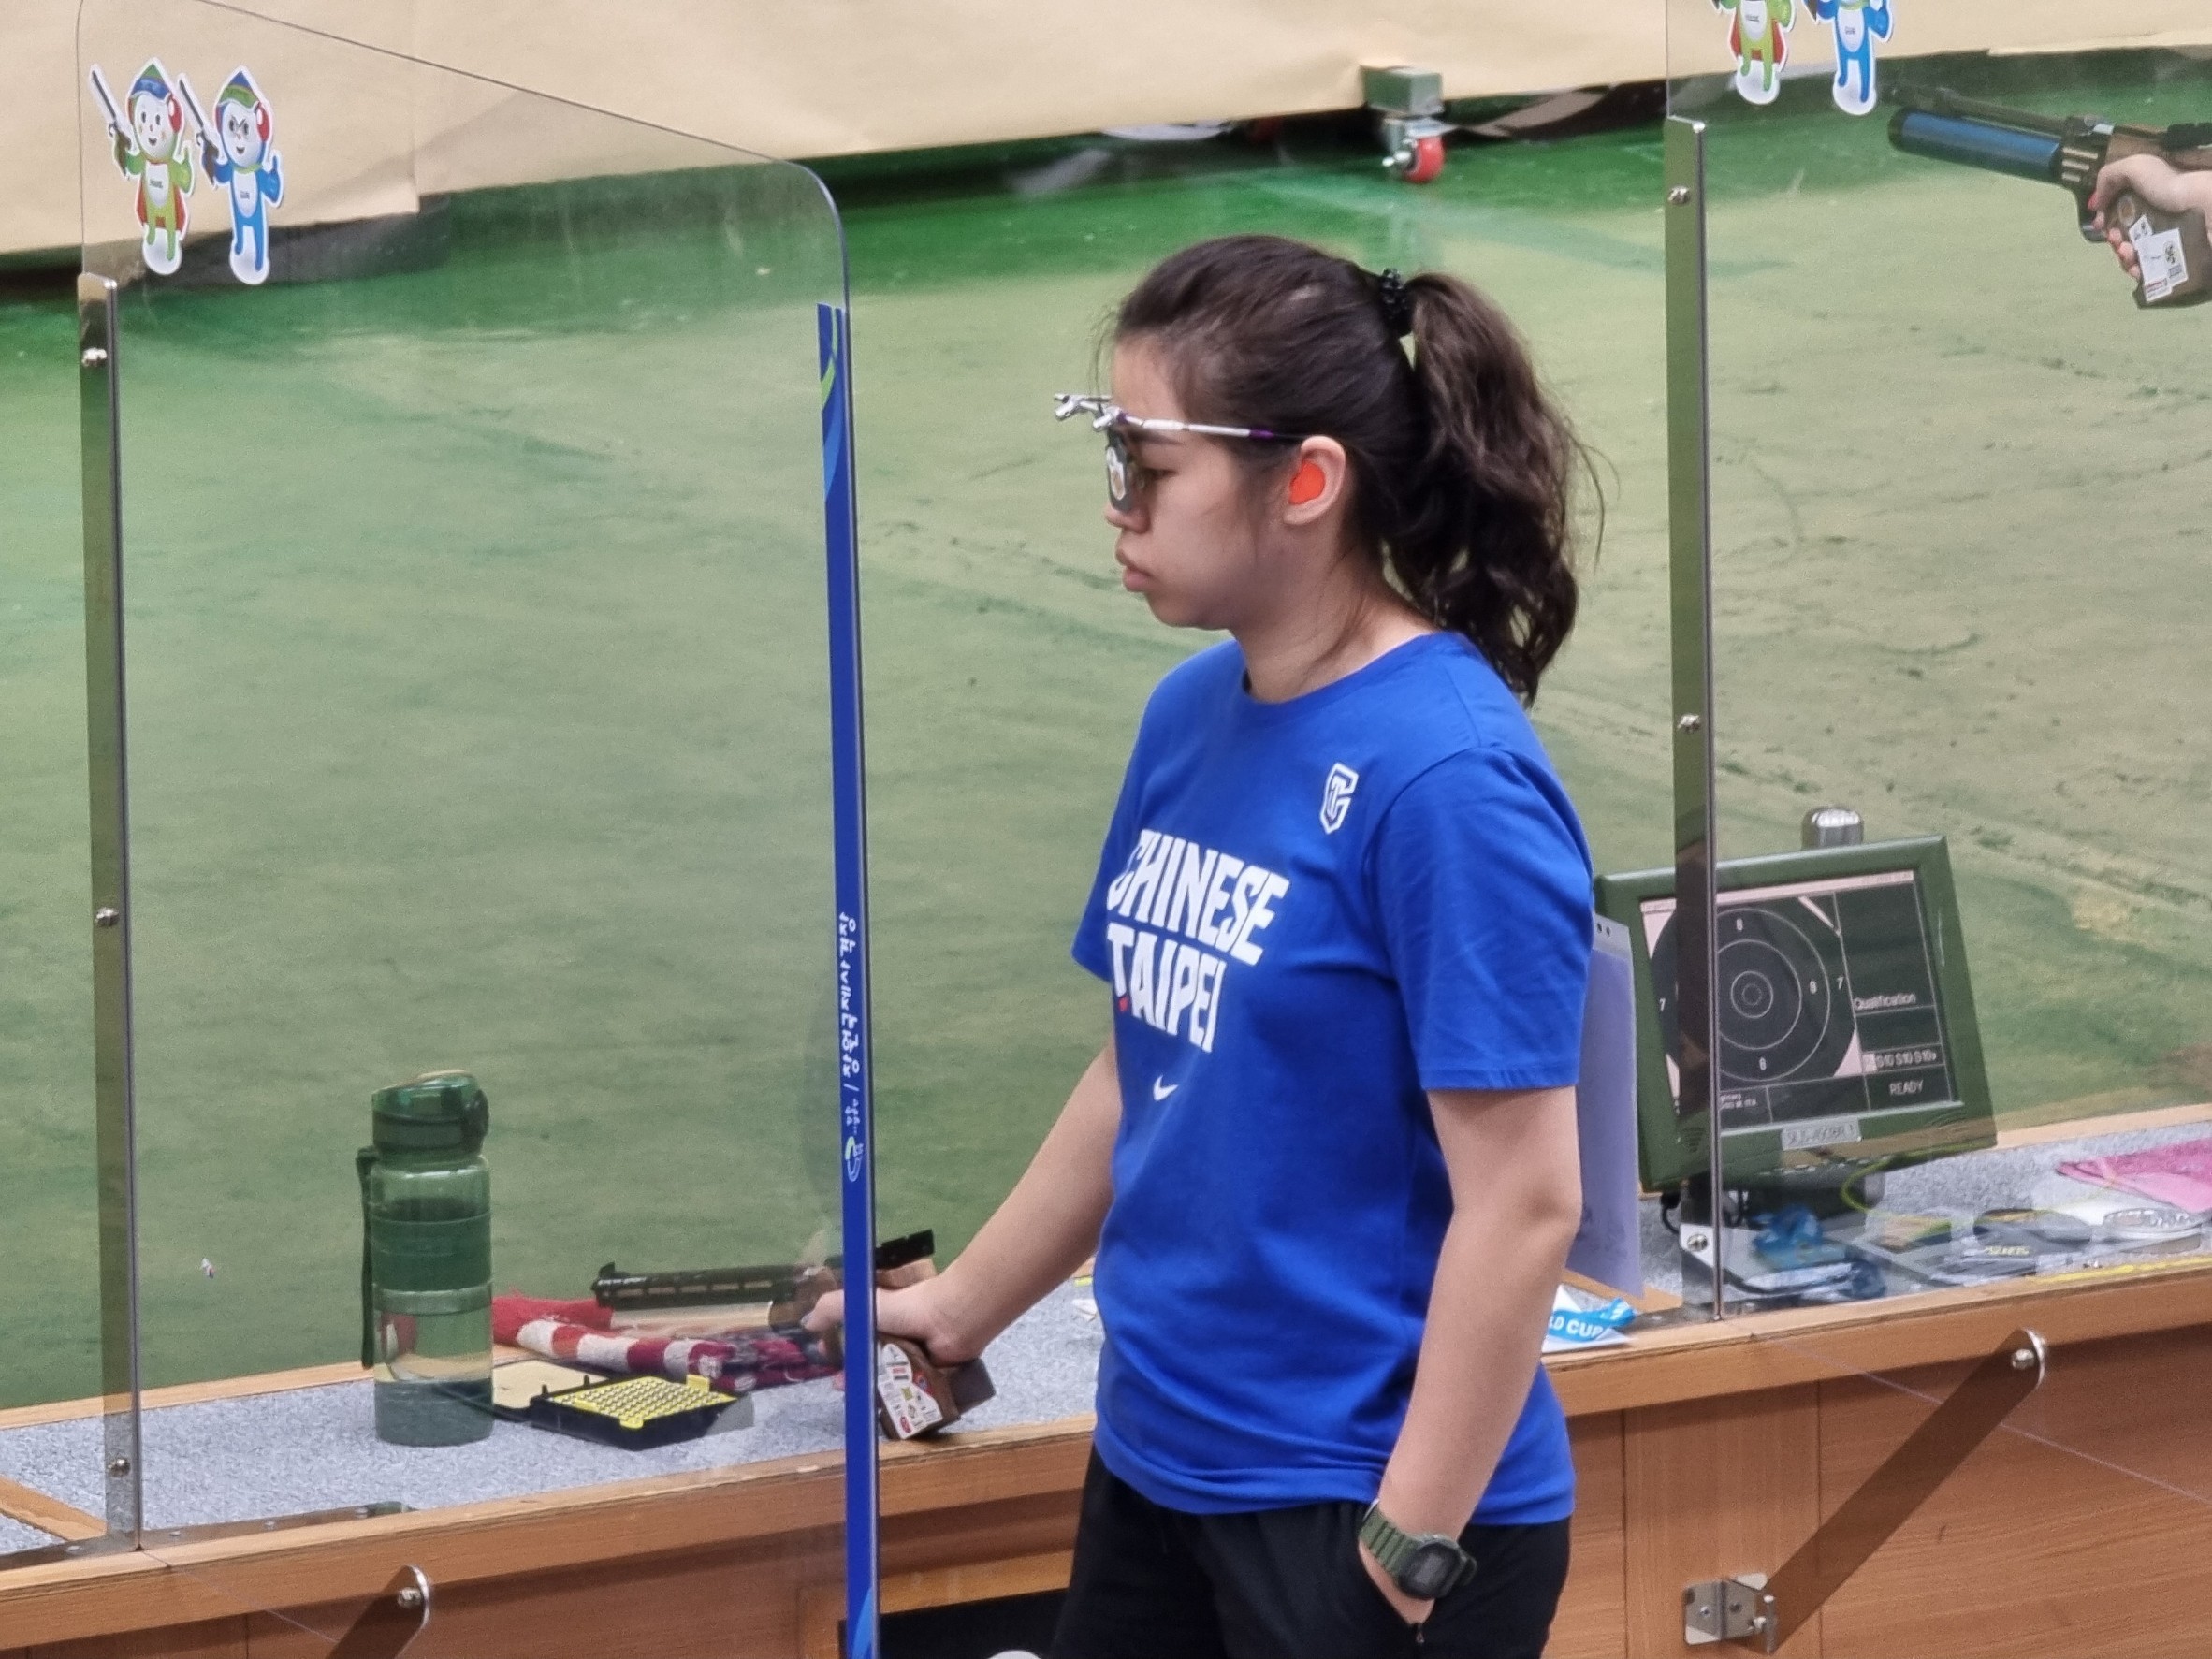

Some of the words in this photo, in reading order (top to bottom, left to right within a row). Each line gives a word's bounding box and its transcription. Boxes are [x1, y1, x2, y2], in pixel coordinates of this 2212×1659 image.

[1107, 829, 1290, 967] CHINESE
[838, 911, 860, 1079] 창원국제사격장
[1107, 923, 1227, 1054] TAIPEI
[1854, 994, 1916, 1011] Qualification
[1889, 1080, 1924, 1096] READY
[1566, 1319, 1604, 1338] CUP
